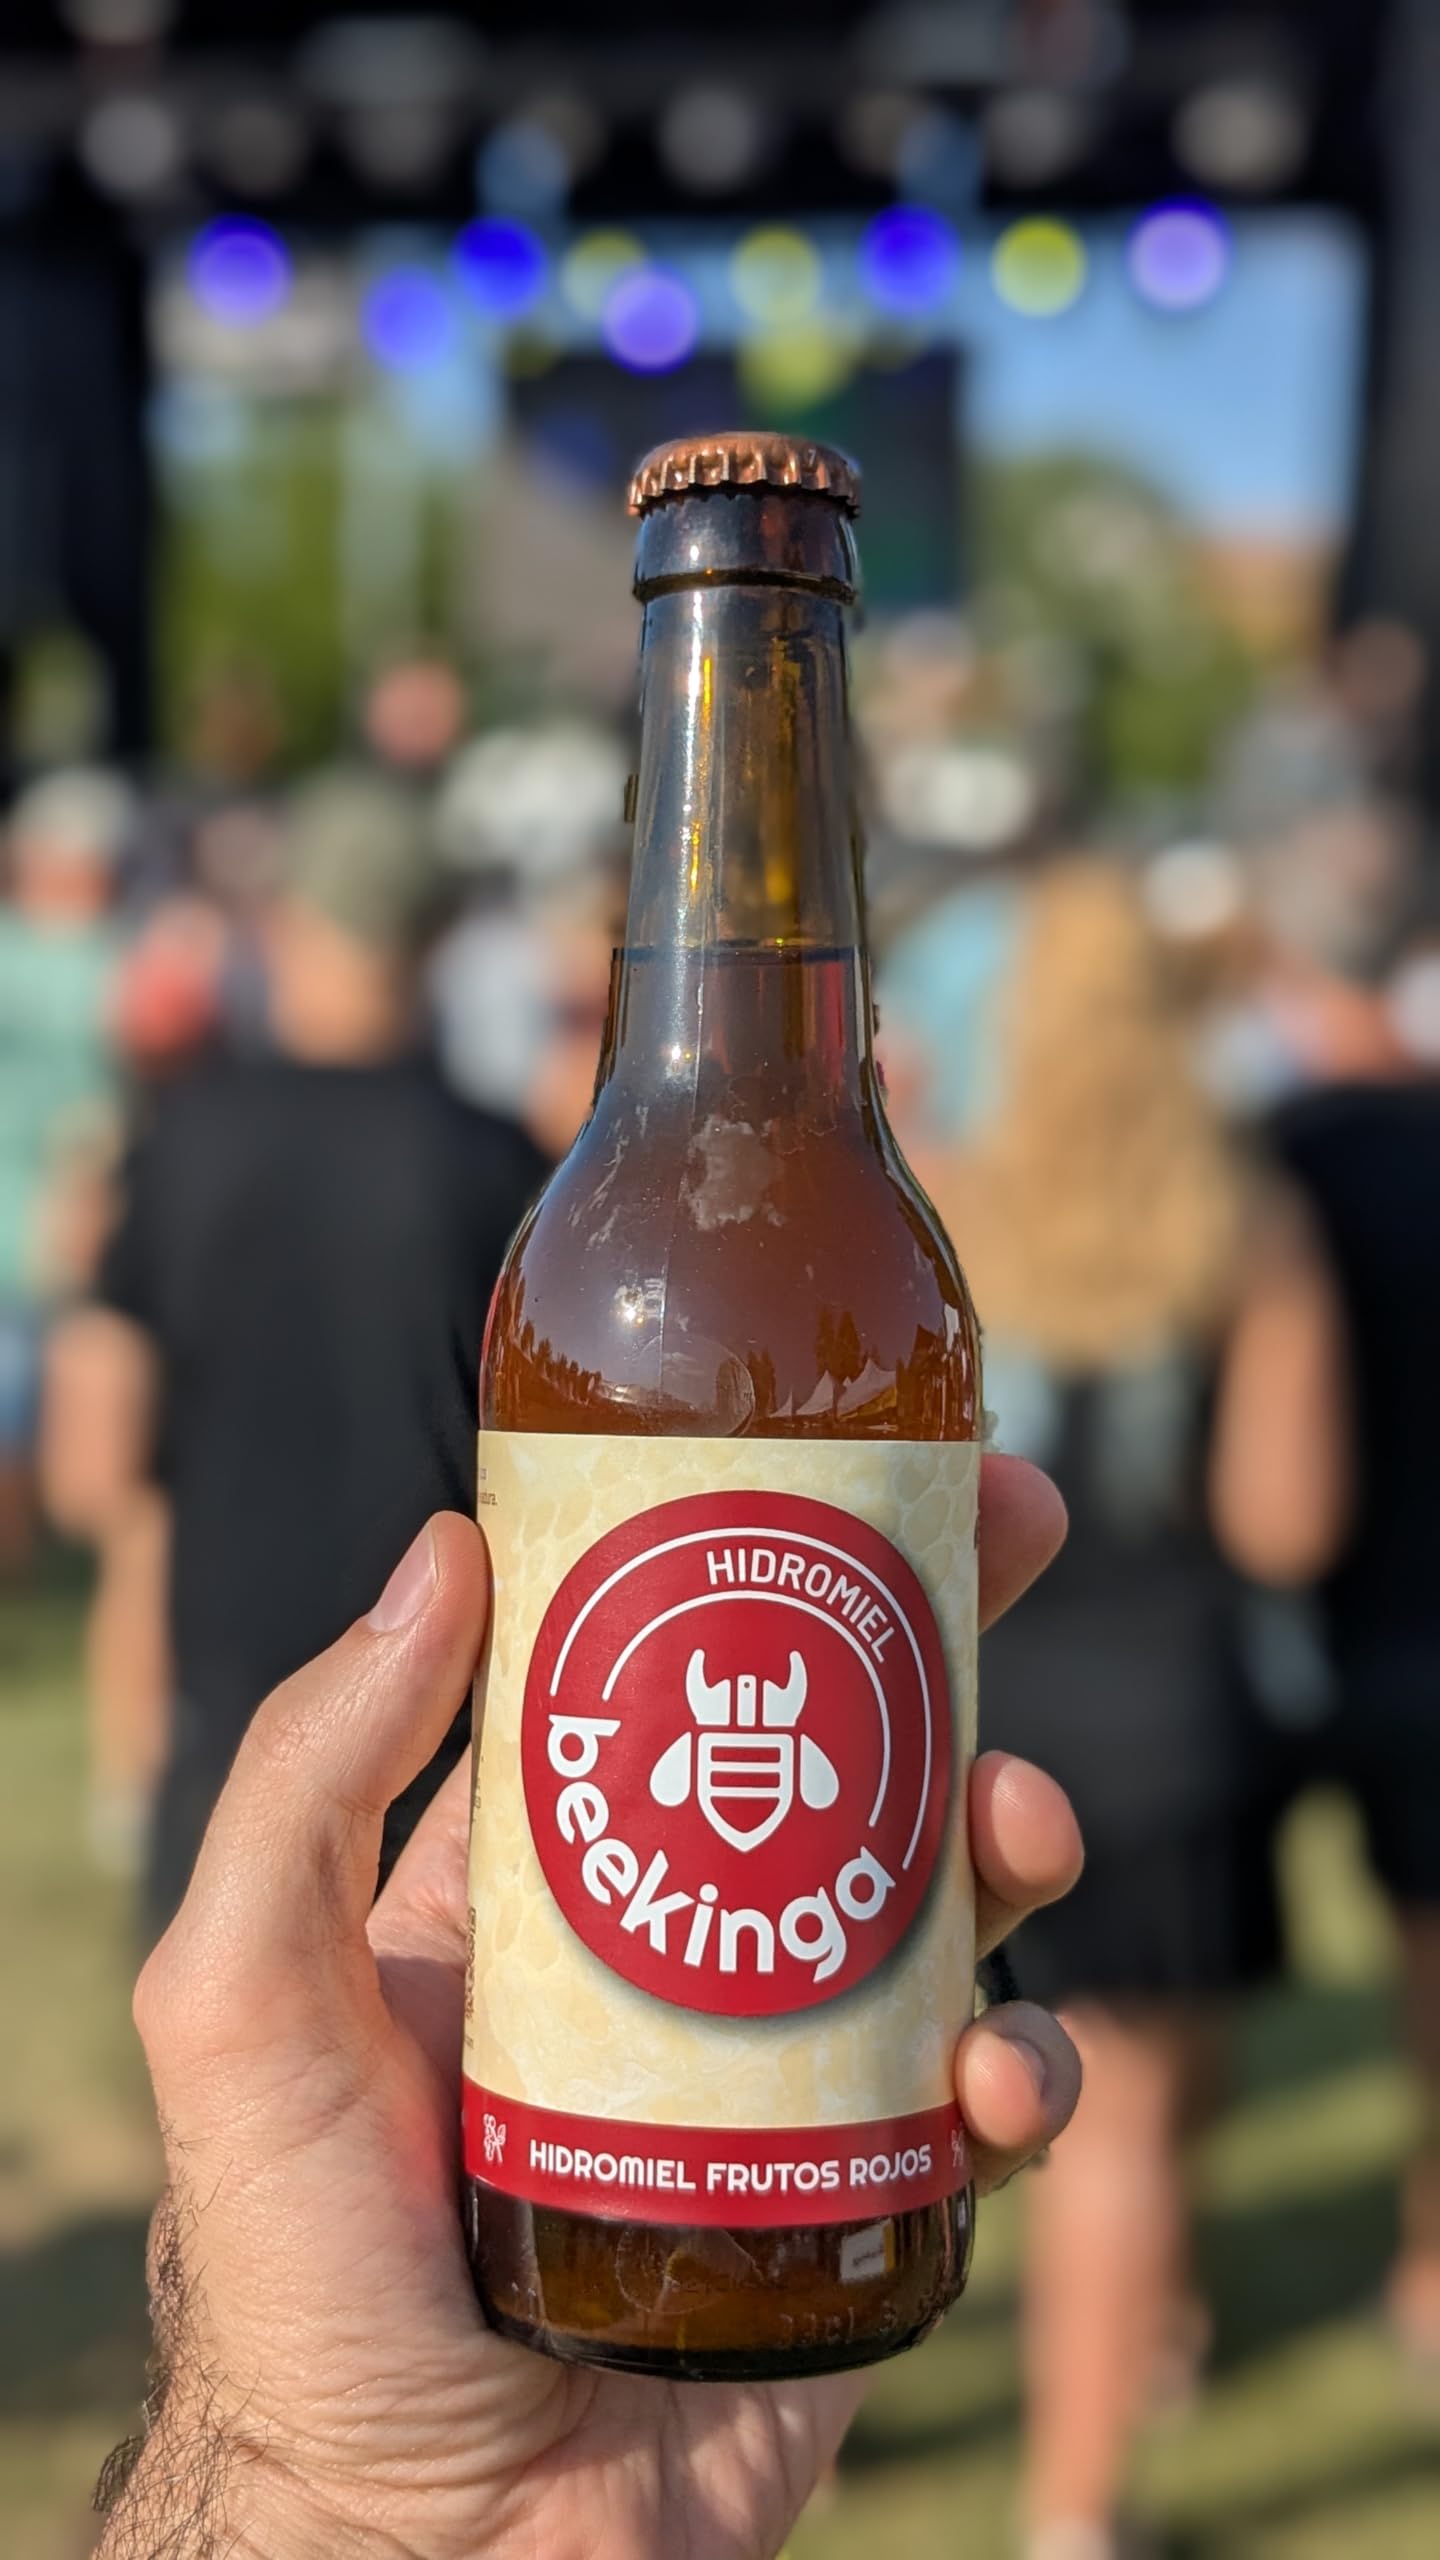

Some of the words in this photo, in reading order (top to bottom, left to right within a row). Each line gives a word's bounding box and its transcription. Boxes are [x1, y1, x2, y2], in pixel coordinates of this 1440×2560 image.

[706, 1548, 895, 1663] HIDROMIEL
[547, 1714, 896, 1983] beekinga
[529, 2139, 697, 2191] HIDROMIEL
[706, 2160, 841, 2192] FRUTOS
[849, 2144, 932, 2187] ROJOS
